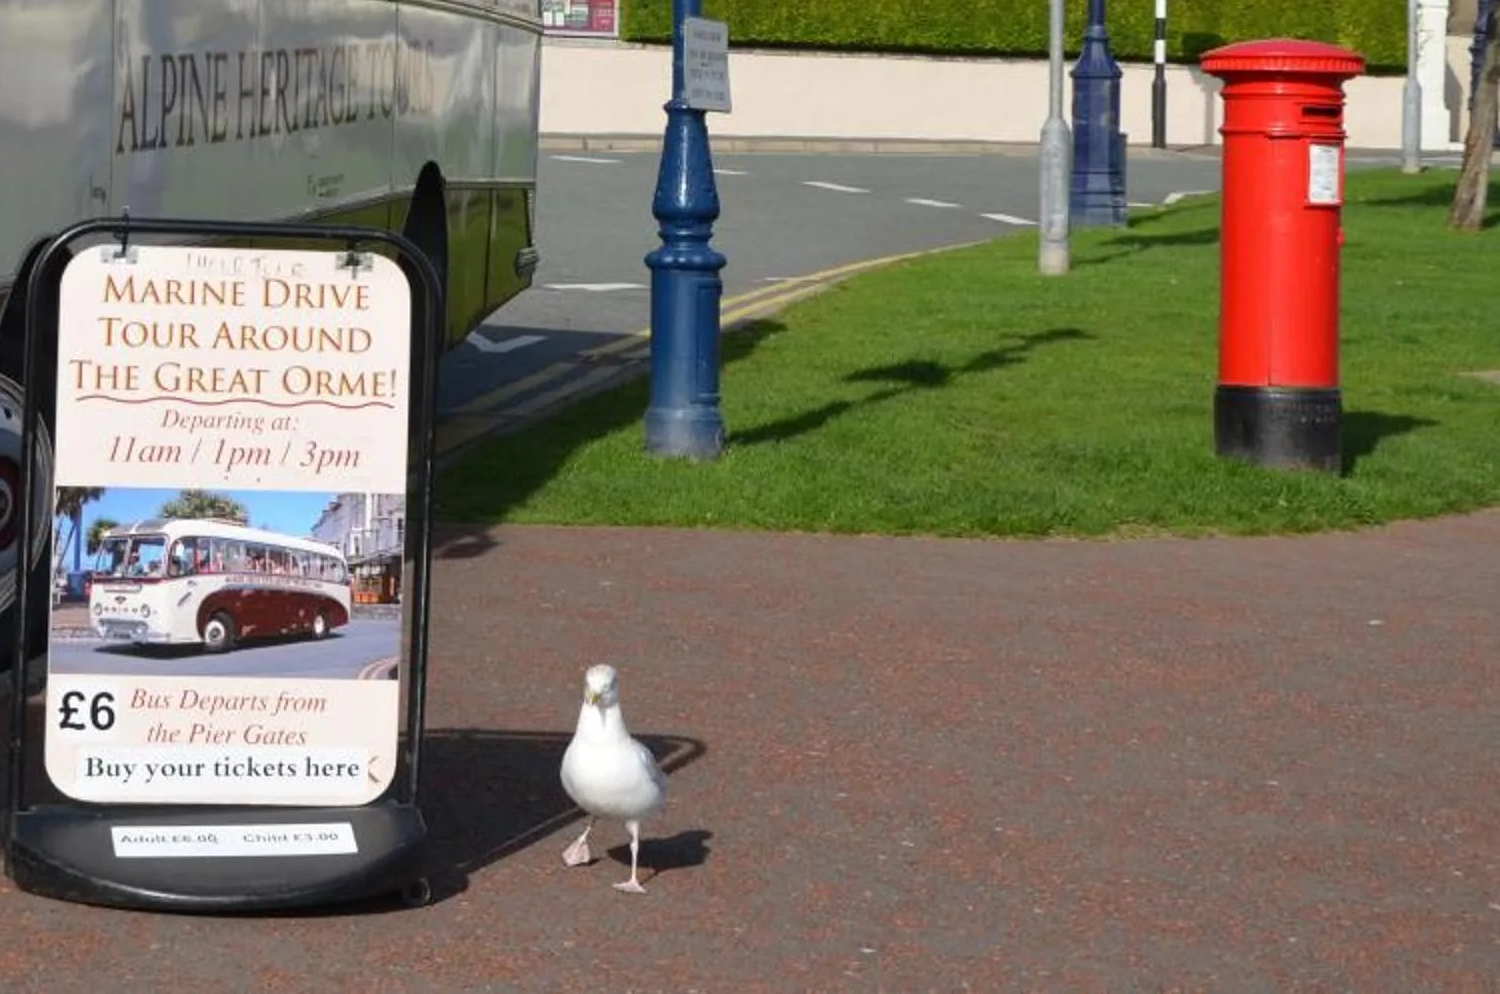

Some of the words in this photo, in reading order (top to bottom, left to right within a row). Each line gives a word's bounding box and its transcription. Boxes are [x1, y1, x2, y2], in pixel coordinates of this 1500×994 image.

[115, 51, 230, 155] ALPINE
[234, 43, 359, 142] HERITAGE
[103, 273, 246, 308] MARINE
[262, 277, 370, 311] DRIVE
[97, 317, 199, 350] TOUR
[211, 320, 373, 354] AROUND
[69, 359, 139, 392] THE
[155, 362, 269, 396] GREAT
[281, 366, 398, 399] ORME!
[160, 408, 266, 435] Departing
[271, 413, 299, 432] at:
[108, 436, 181, 465] 11am
[213, 439, 270, 472] 1pm
[299, 445, 360, 476] 3pm
[57, 690, 117, 732] £6
[130, 687, 171, 710] Bus
[179, 689, 267, 714] Departs
[273, 690, 327, 716] from
[146, 723, 181, 744] the
[189, 725, 236, 744] Pier
[243, 724, 308, 746] Gates
[85, 757, 136, 783] Buy
[145, 762, 206, 784] your
[214, 757, 298, 777] tickets
[305, 757, 360, 777] here
